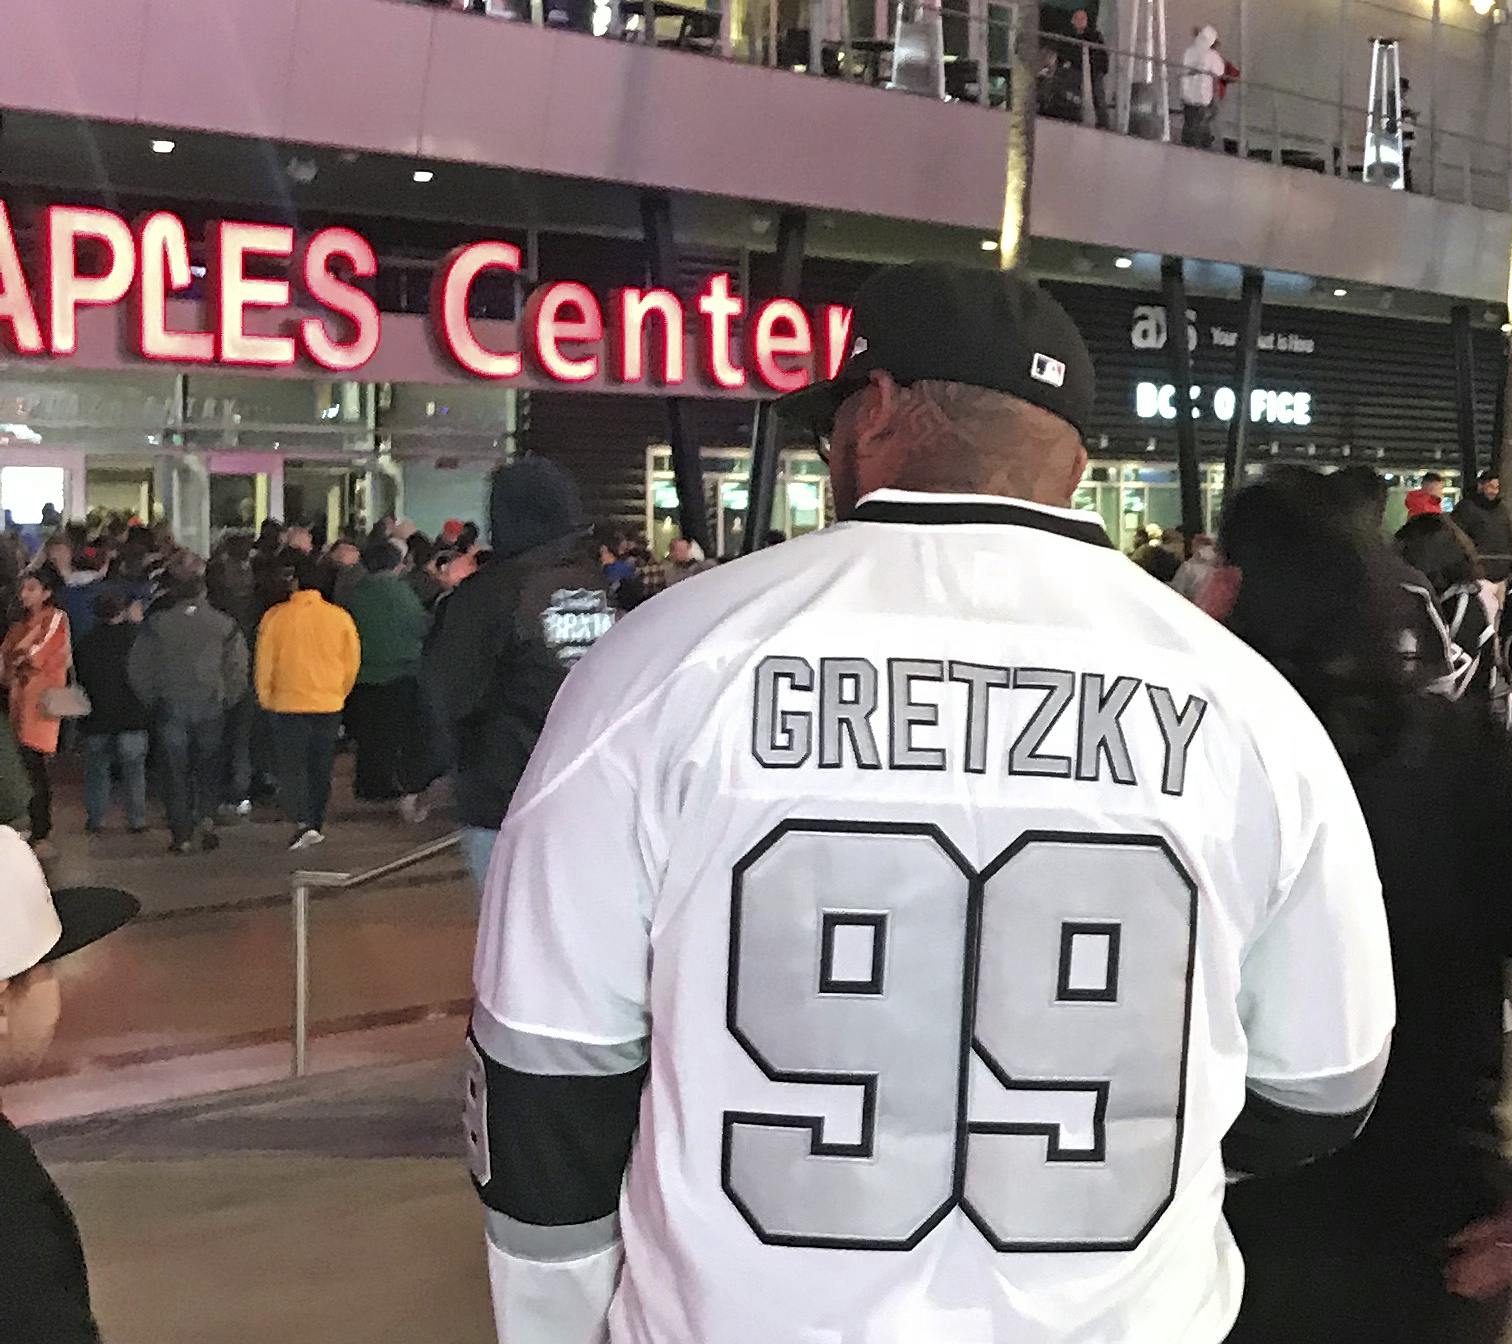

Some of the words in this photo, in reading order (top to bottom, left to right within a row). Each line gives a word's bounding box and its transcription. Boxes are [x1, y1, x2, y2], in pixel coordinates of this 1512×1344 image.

[1213, 387, 1312, 425] OFICE
[750, 655, 1209, 796] GRETZKY
[721, 817, 1200, 1254] 99
